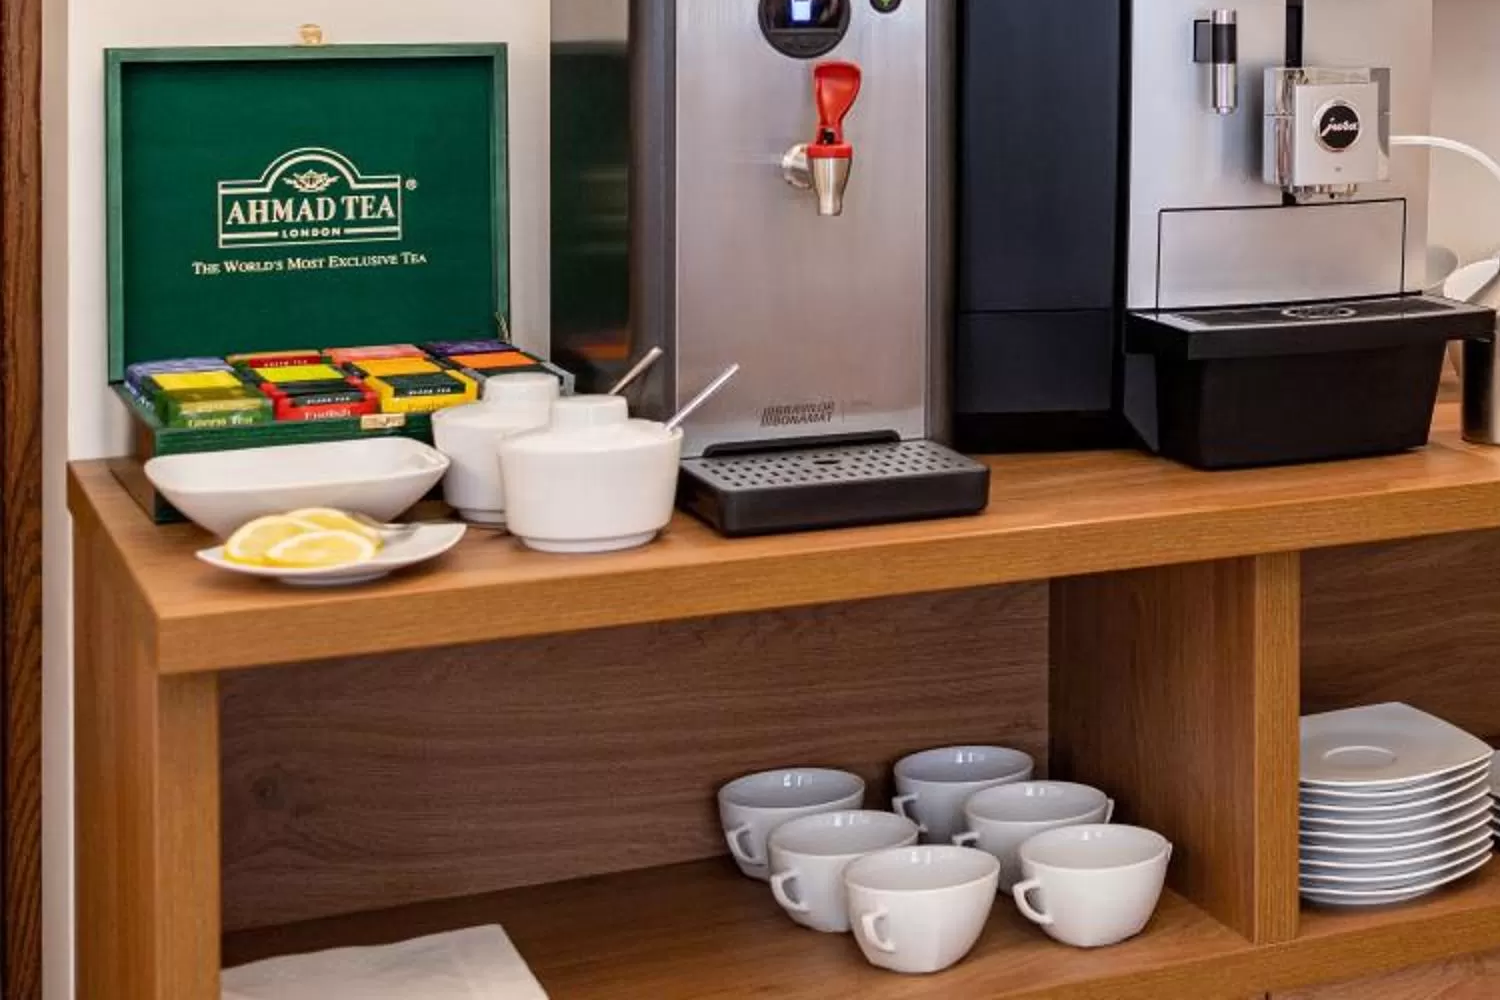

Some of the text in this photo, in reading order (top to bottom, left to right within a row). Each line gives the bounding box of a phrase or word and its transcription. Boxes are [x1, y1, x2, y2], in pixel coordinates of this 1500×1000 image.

[225, 194, 396, 225] AHMAD TEA
[281, 227, 341, 239] LONDON
[192, 251, 428, 275] THE WORLD'S MOST EXCLUSIVE TEA
